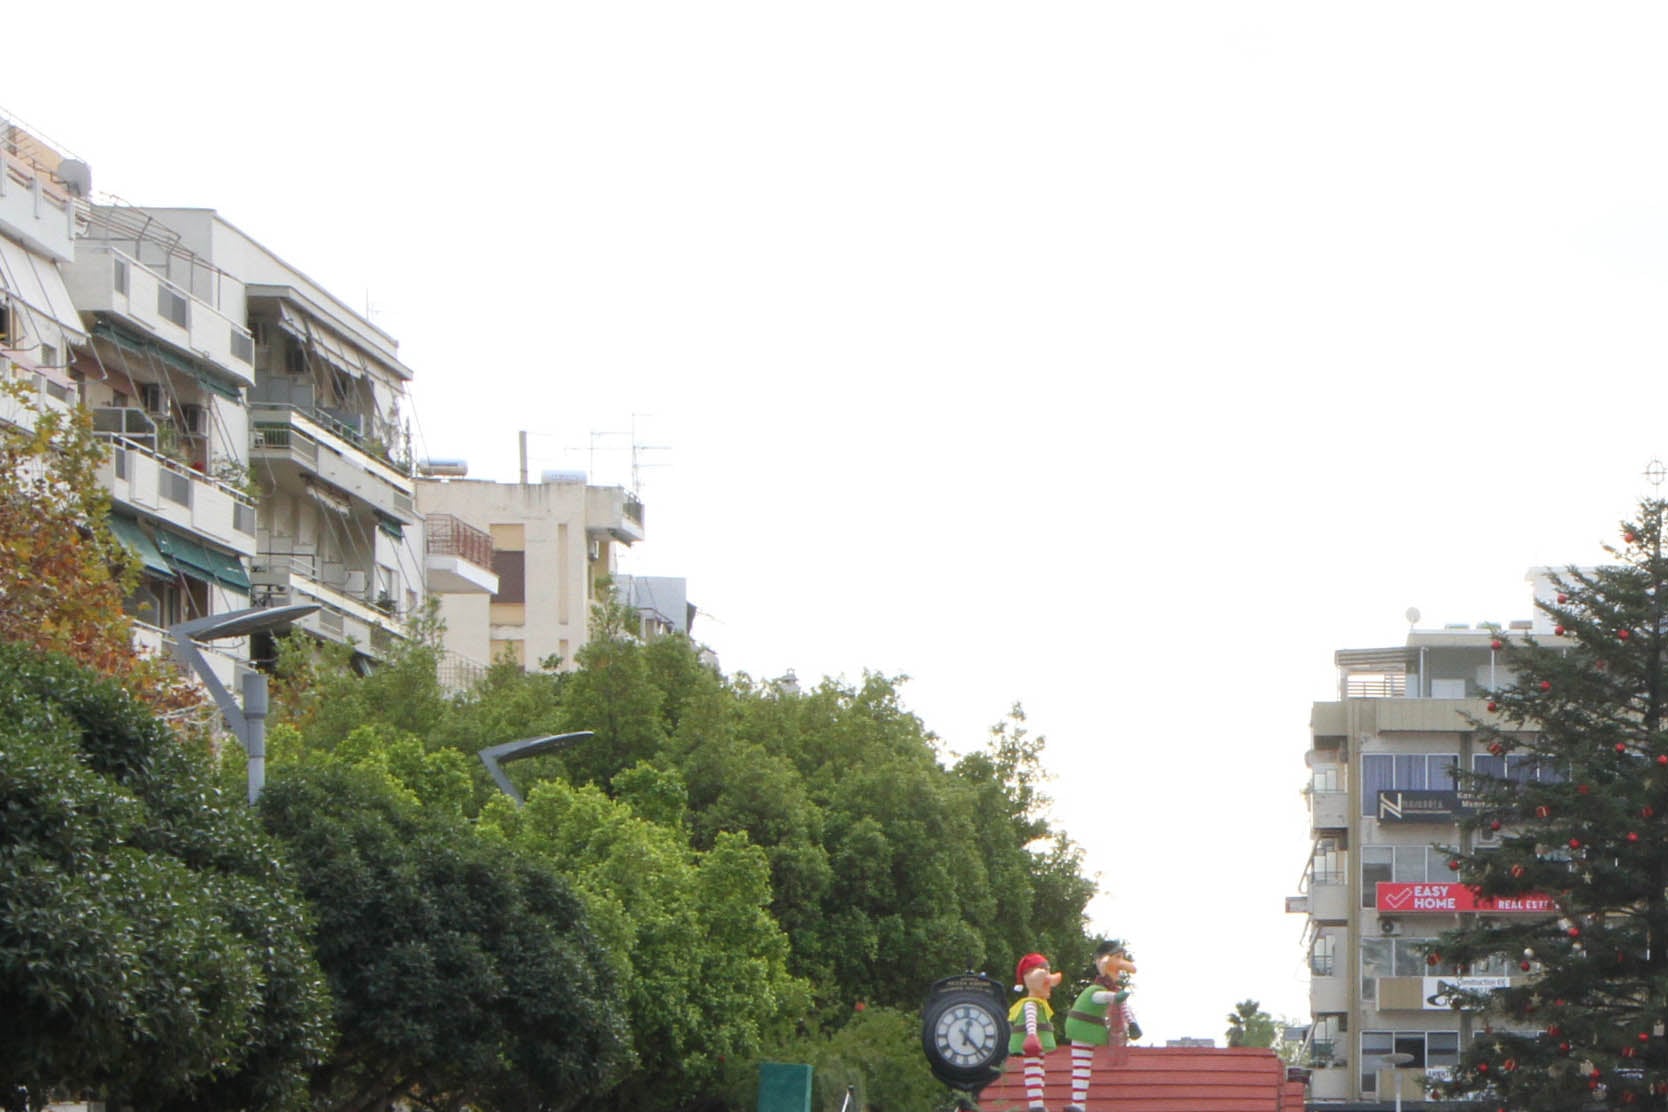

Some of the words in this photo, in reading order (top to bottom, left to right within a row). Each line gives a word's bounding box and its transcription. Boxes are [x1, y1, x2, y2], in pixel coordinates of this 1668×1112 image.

[1414, 886, 1449, 897] EASY
[1414, 898, 1456, 909] HOME
[1498, 900, 1523, 909] REAL
